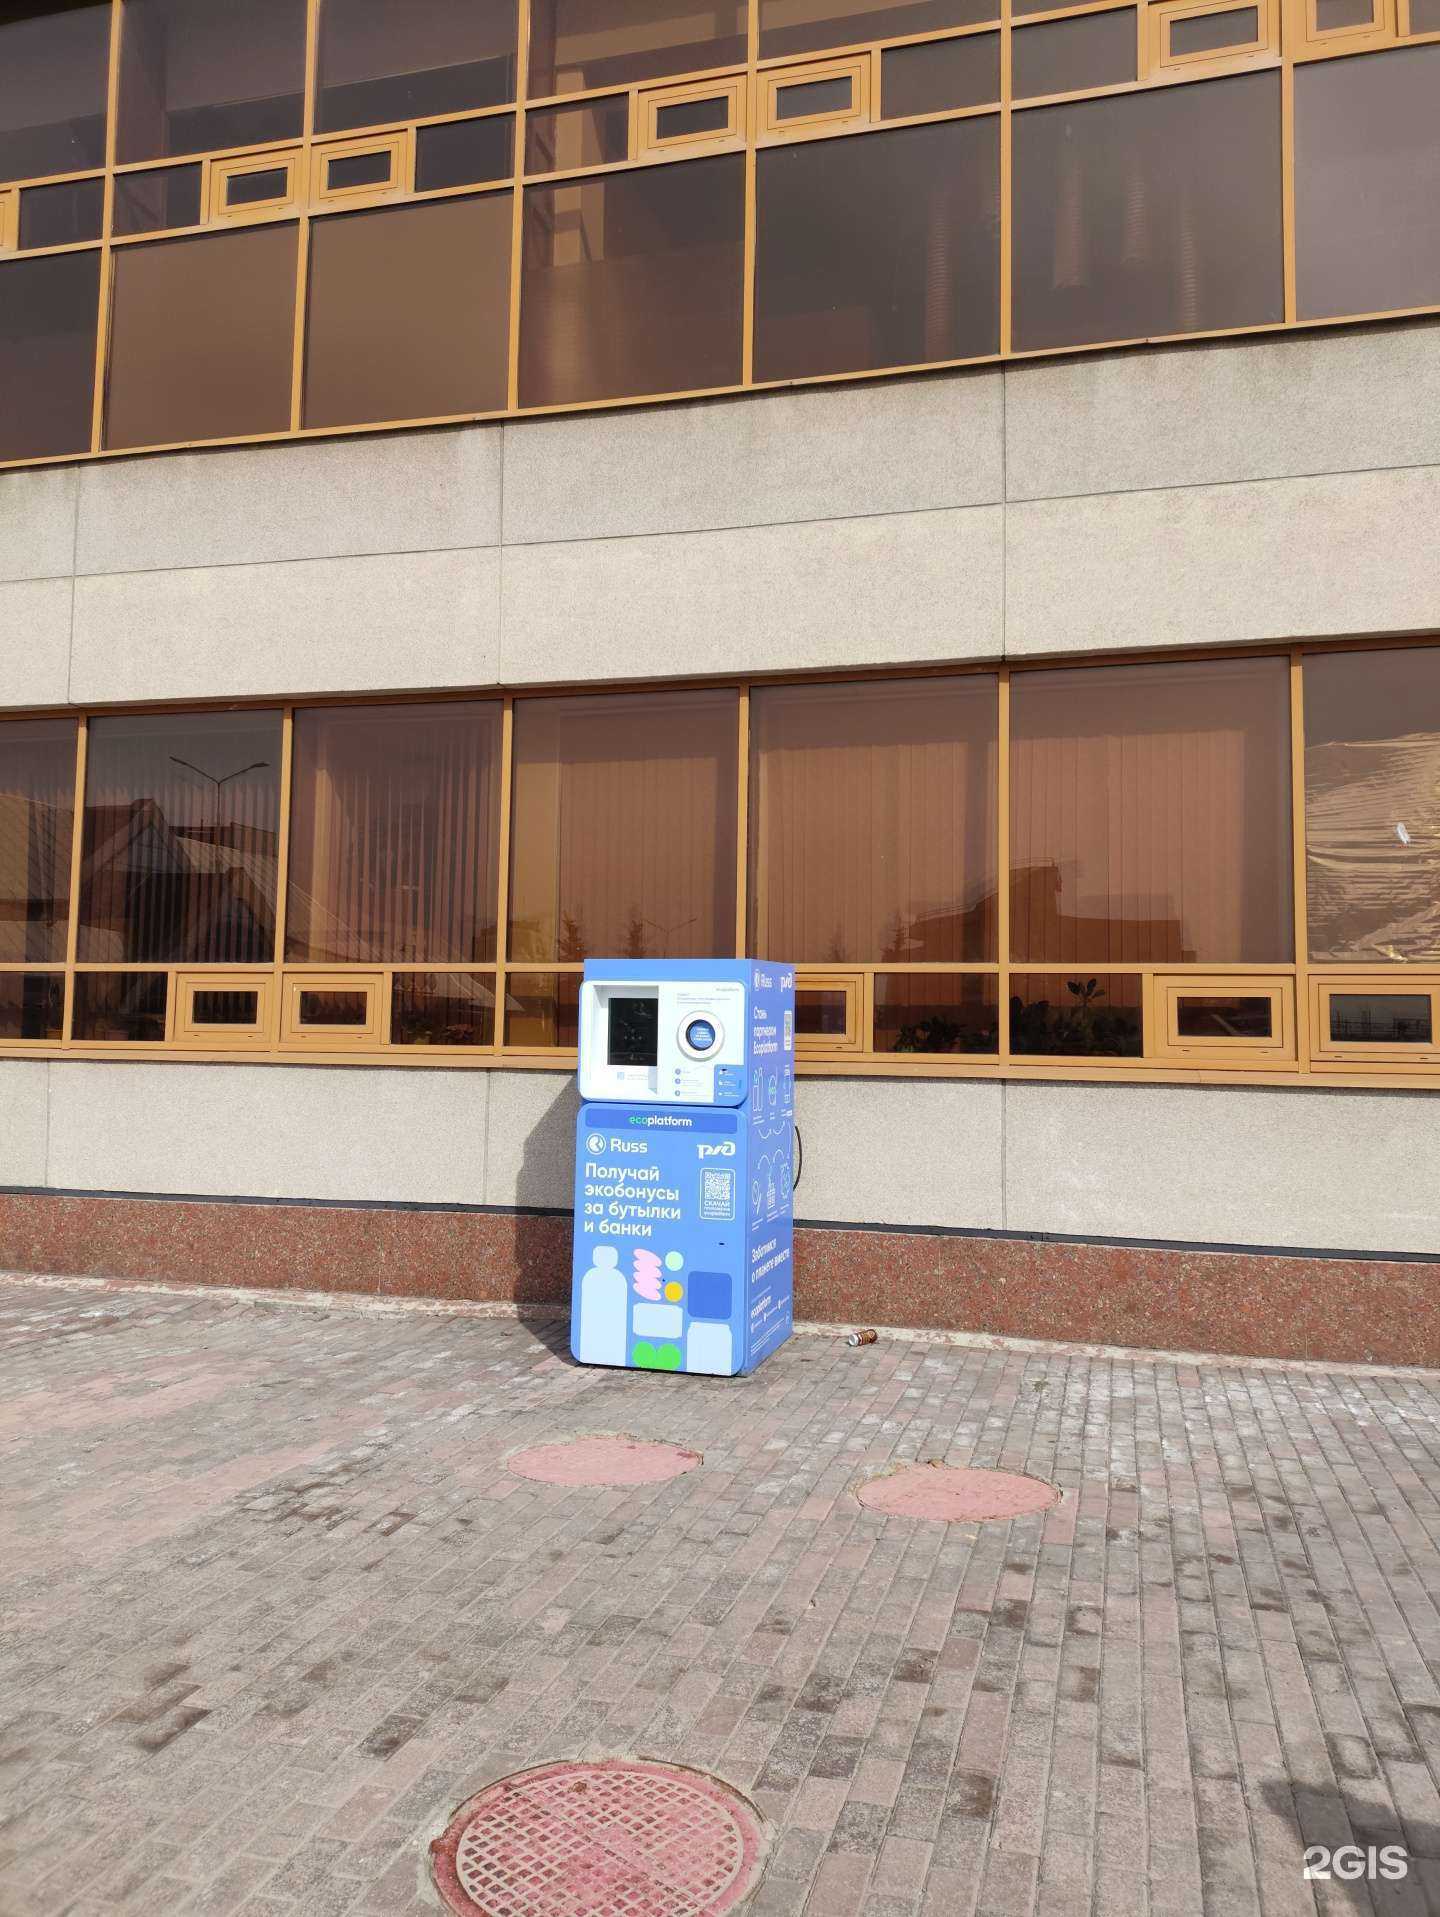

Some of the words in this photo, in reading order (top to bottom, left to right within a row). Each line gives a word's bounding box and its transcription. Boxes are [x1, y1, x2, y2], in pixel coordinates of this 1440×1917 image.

[629, 1115, 693, 1127] ecoplatform
[610, 1137, 648, 1153] Russ
[585, 1162, 660, 1182] Получай
[584, 1182, 680, 1204] экобонусы
[584, 1202, 604, 1215] за
[608, 1201, 681, 1220] бутылки
[584, 1220, 594, 1233] и
[599, 1218, 652, 1237] банки
